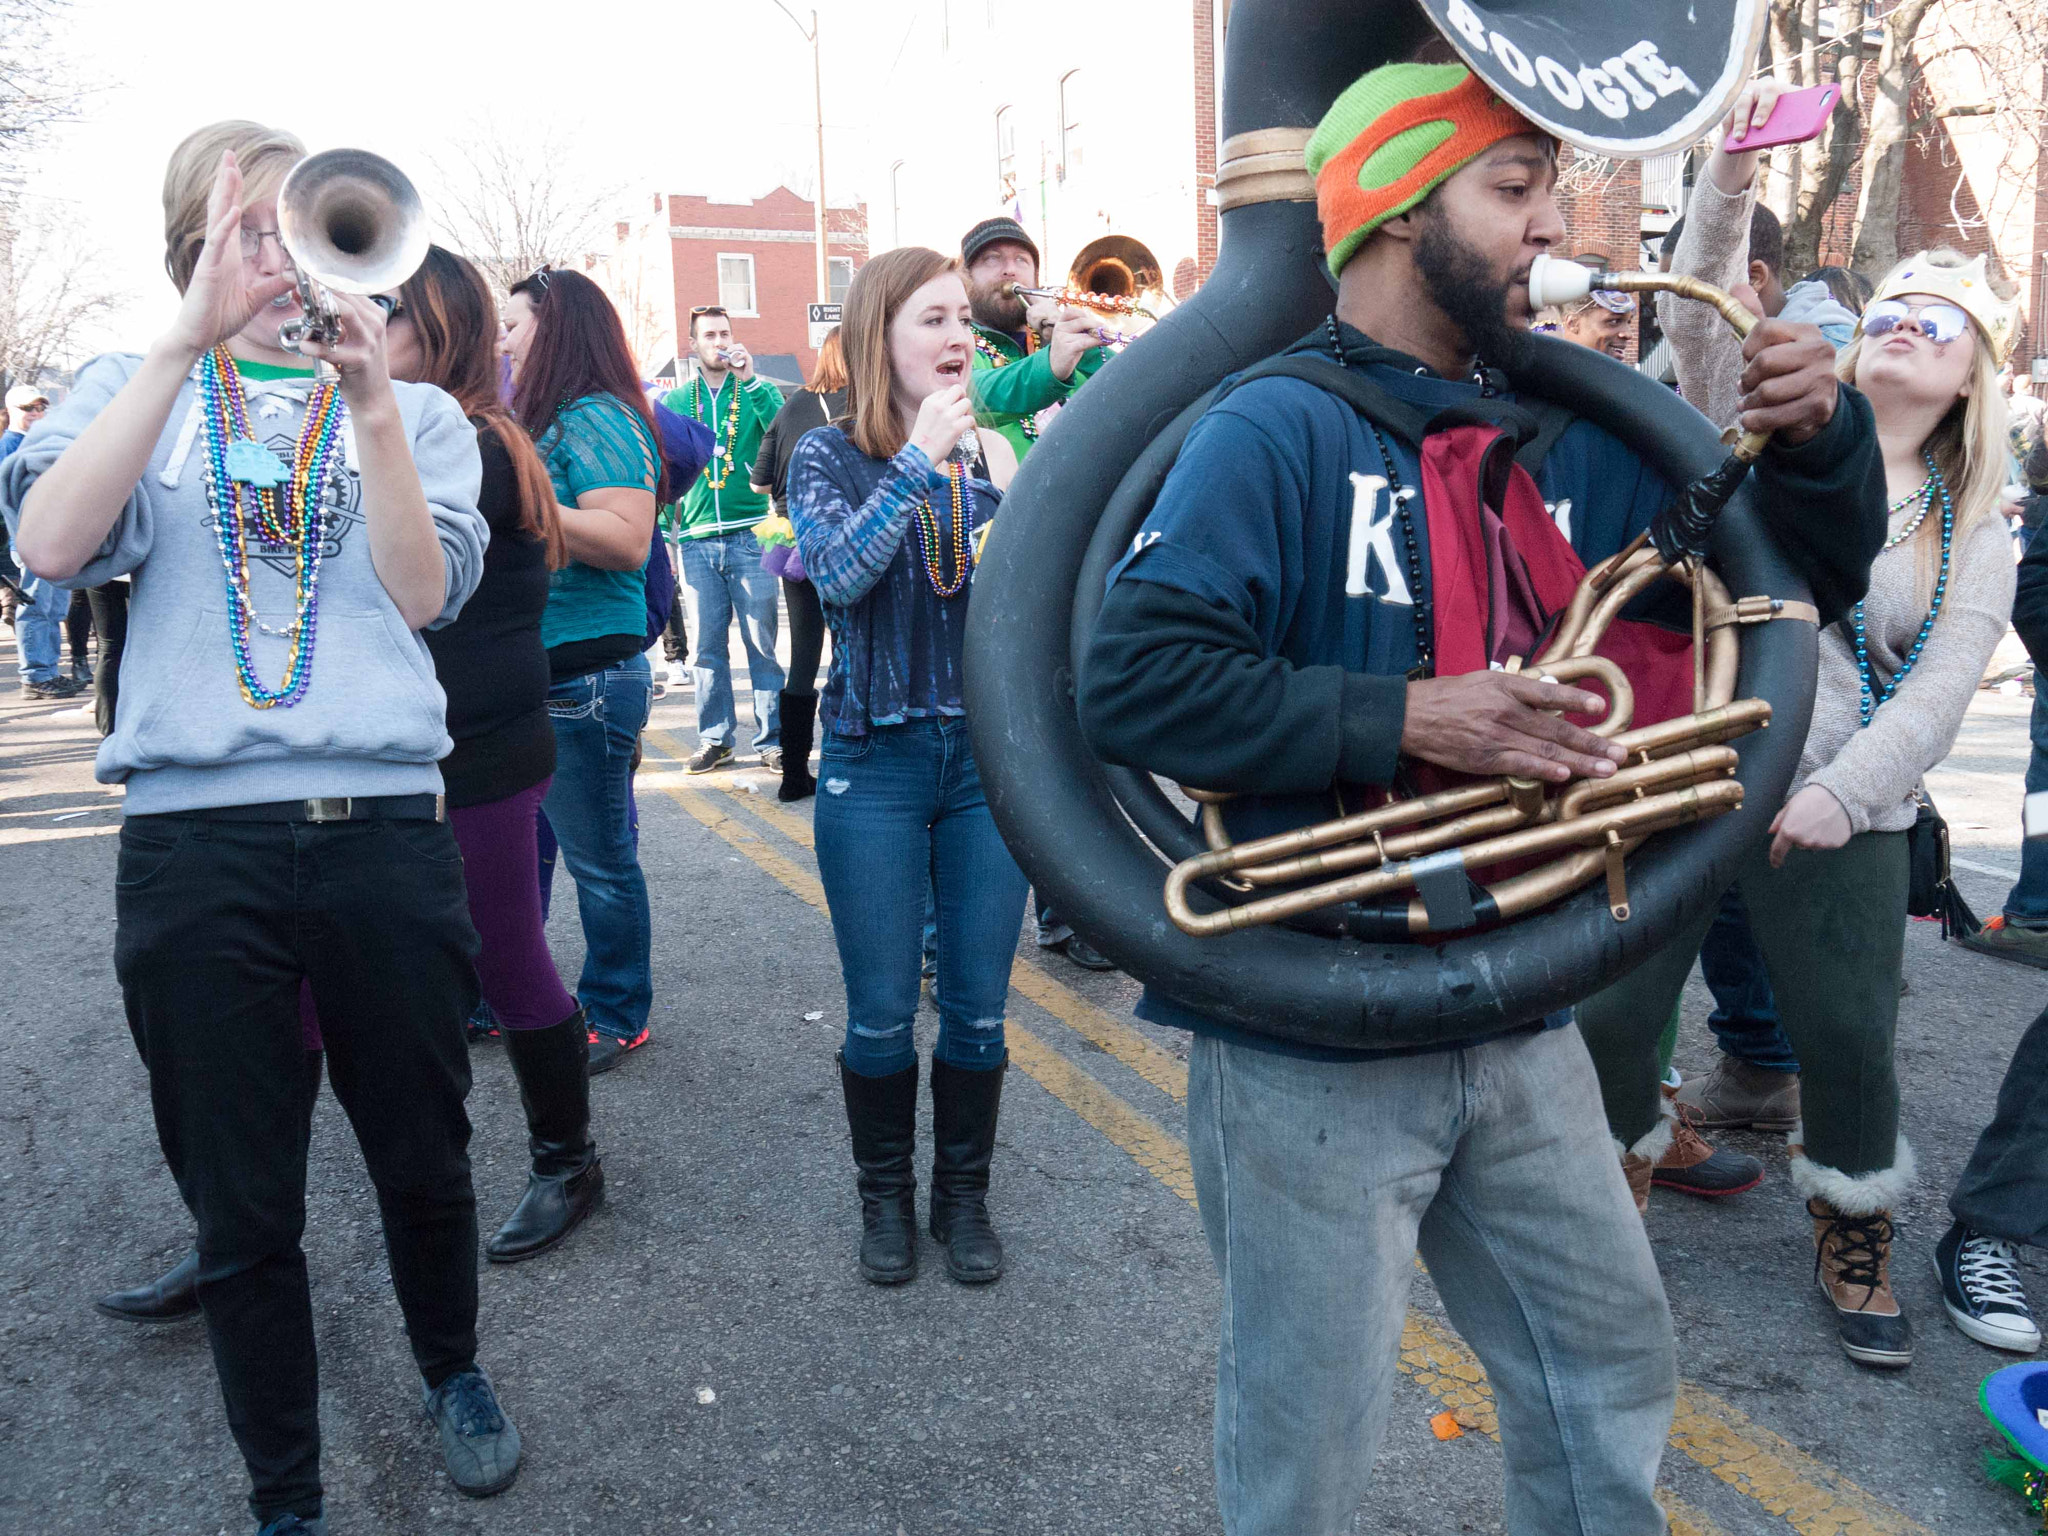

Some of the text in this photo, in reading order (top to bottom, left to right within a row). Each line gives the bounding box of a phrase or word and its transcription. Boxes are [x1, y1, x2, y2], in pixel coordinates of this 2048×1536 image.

[1447, 0, 1700, 119] BOOGIE
[650, 379, 673, 389] TM
[260, 545, 285, 554] BIKE
